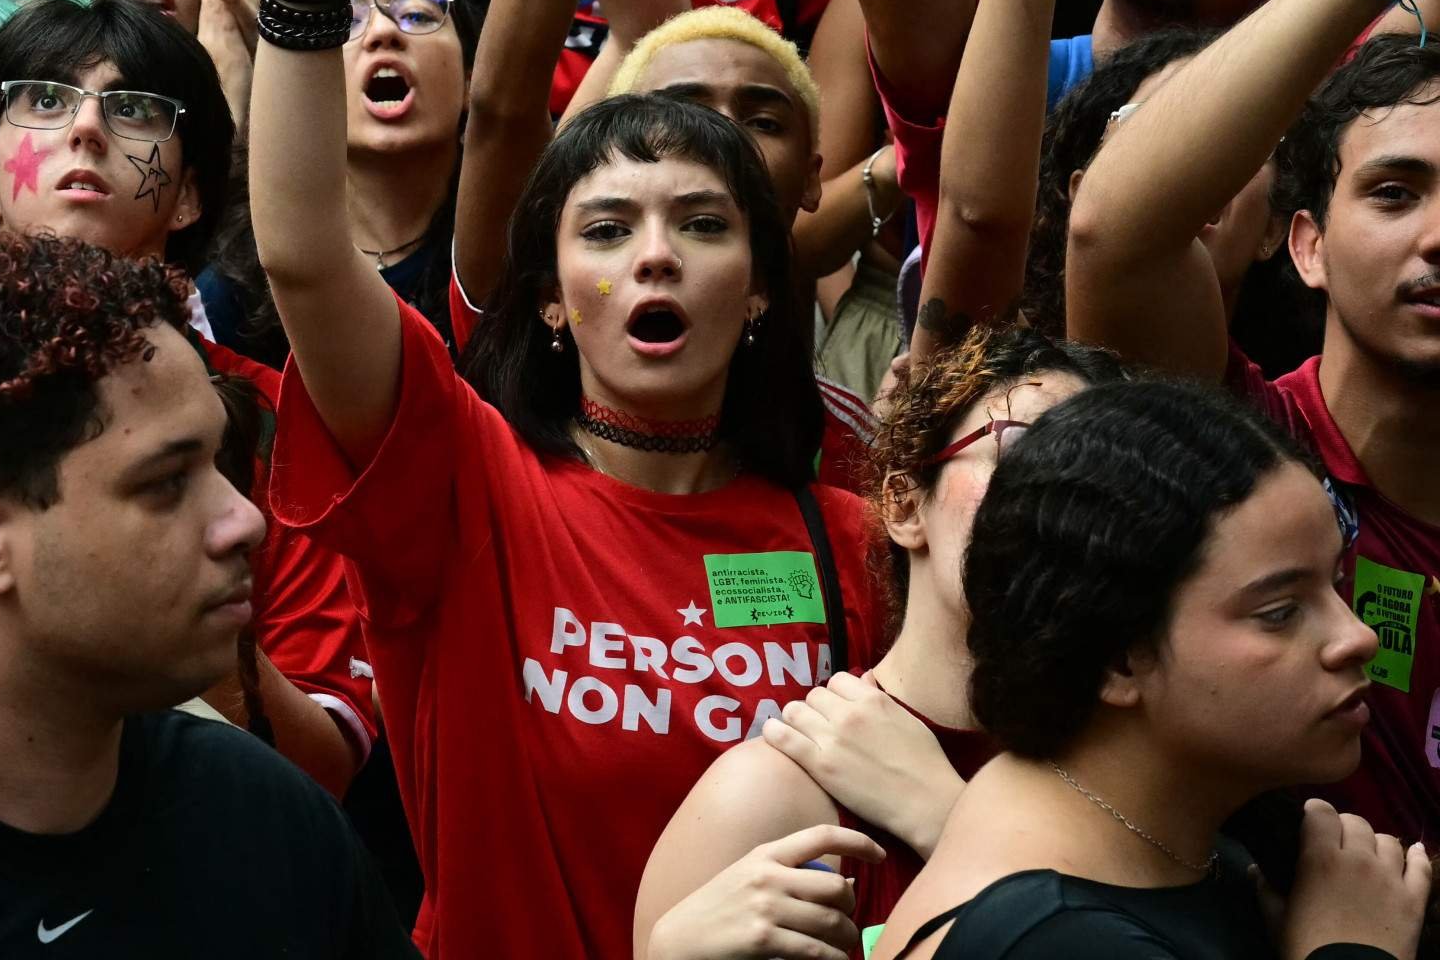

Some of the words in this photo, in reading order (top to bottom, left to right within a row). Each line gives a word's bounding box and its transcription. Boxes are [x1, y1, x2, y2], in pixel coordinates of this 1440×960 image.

[712, 568, 768, 577] antirracista,
[713, 578, 739, 587] LGBT,
[740, 576, 787, 585] feminista,
[715, 587, 785, 596] ecossocialista,
[1383, 585, 1413, 601] FUTURO
[725, 595, 790, 605] ANTIFASCISTA!
[550, 607, 832, 687] PERSONA
[523, 657, 672, 735] NON
